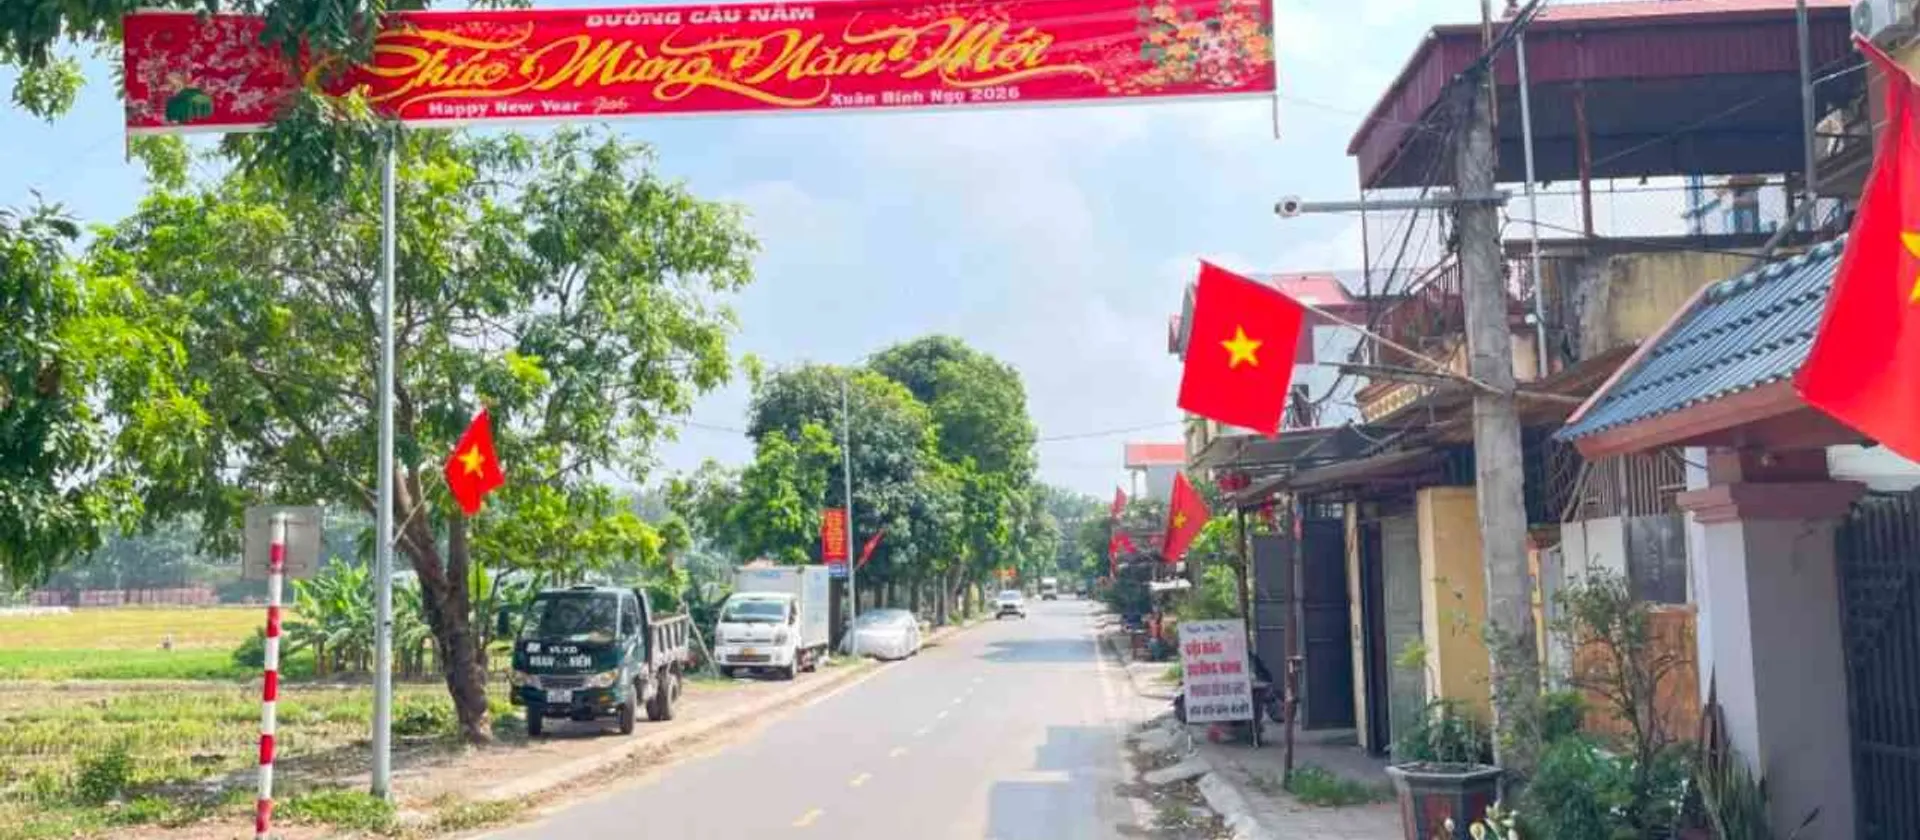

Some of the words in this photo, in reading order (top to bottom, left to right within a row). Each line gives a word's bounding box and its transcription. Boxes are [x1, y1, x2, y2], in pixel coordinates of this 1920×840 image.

[728, 28, 888, 84] Năm
[895, 17, 1054, 86] Mới
[830, 92, 876, 106] Xuân
[971, 86, 1021, 100] 2026
[428, 102, 488, 118] Happy
[495, 101, 534, 113] New
[541, 99, 581, 112] Year
